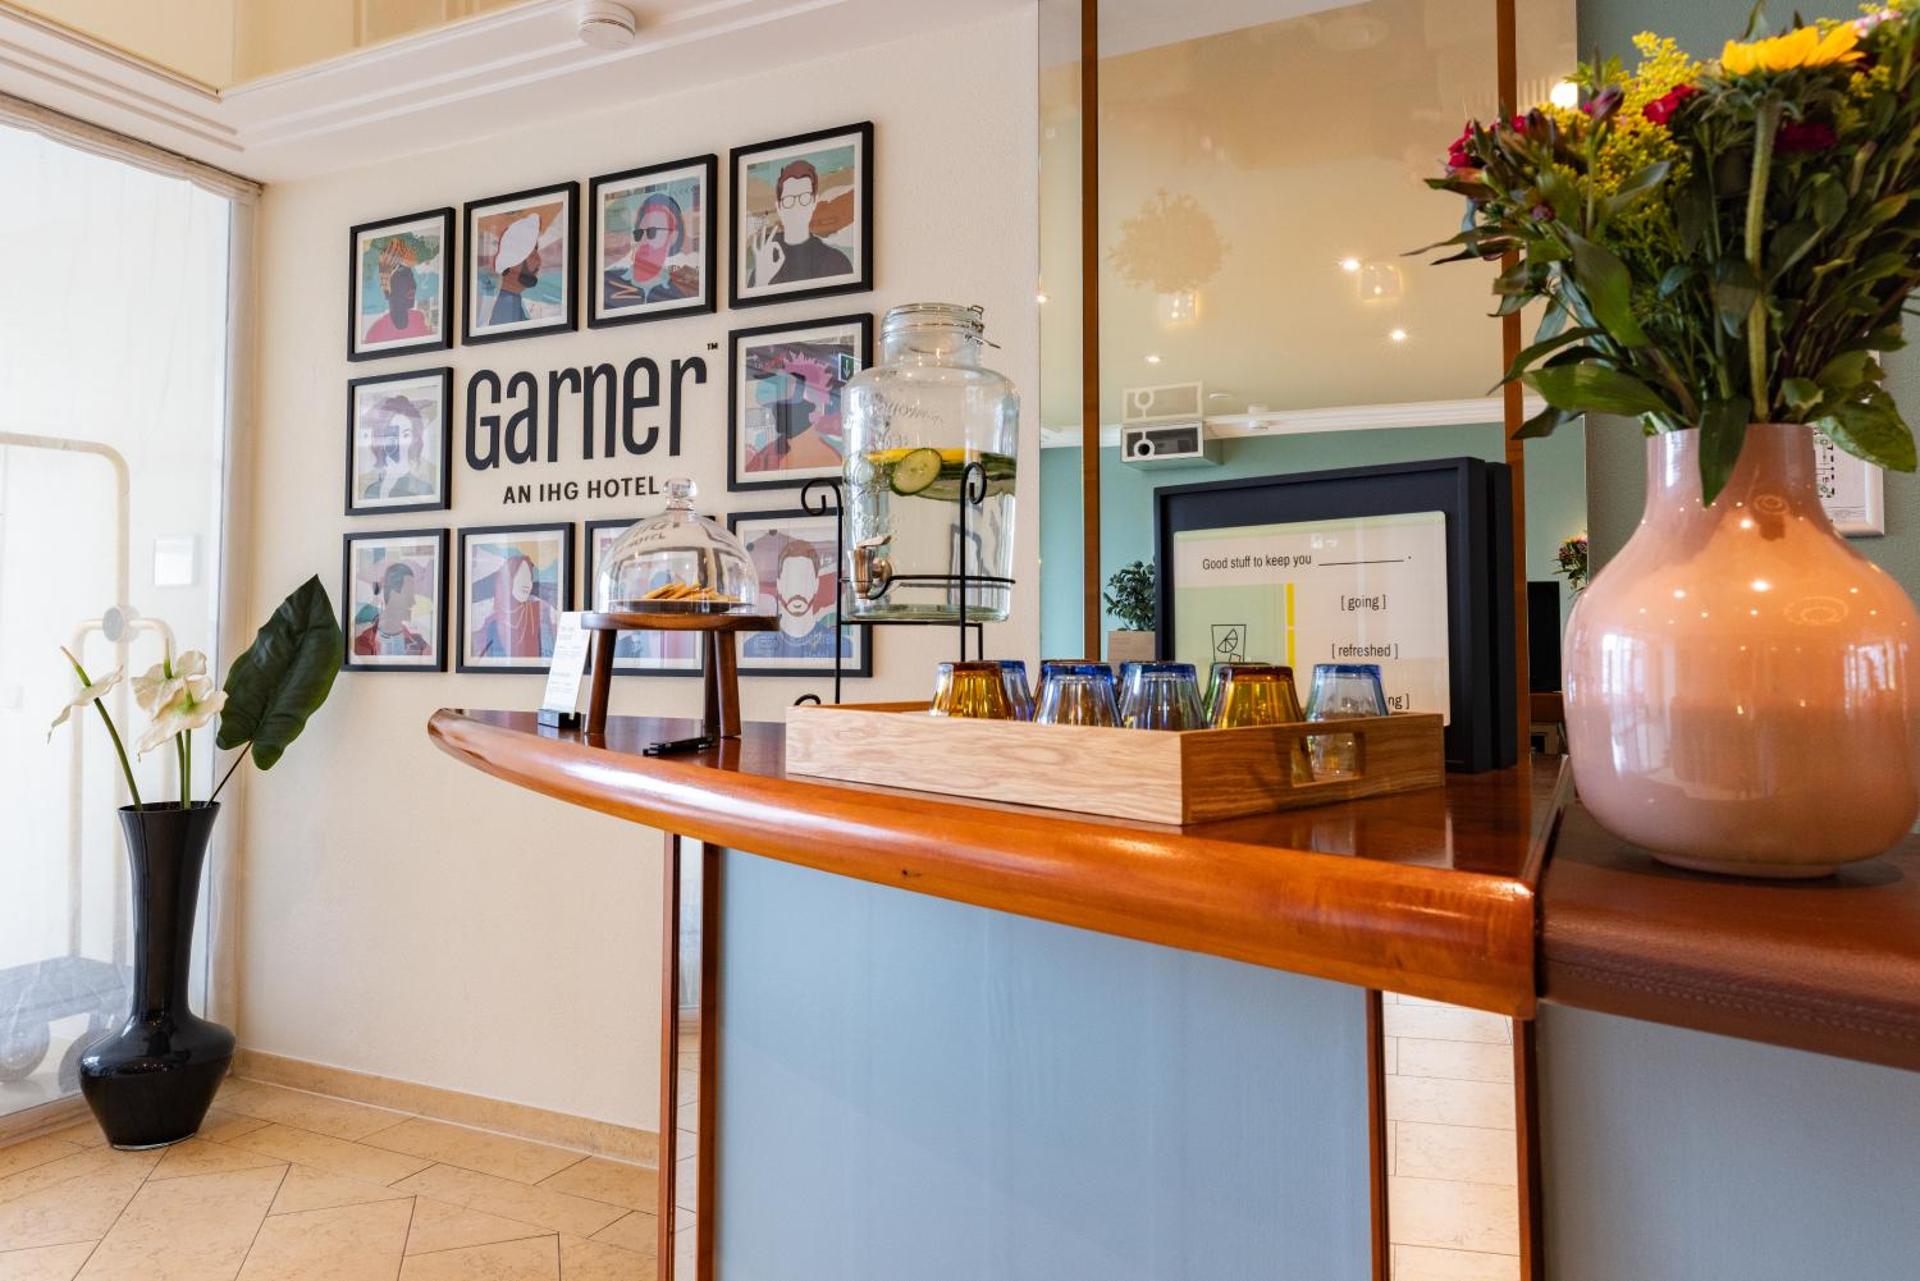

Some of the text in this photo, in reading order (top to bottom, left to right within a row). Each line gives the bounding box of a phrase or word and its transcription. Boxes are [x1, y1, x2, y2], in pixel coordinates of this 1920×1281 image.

[465, 356, 708, 471] Garner
[502, 475, 660, 504] AN IHG HOTEL
[1202, 554, 1312, 570] Good stuff to keep you
